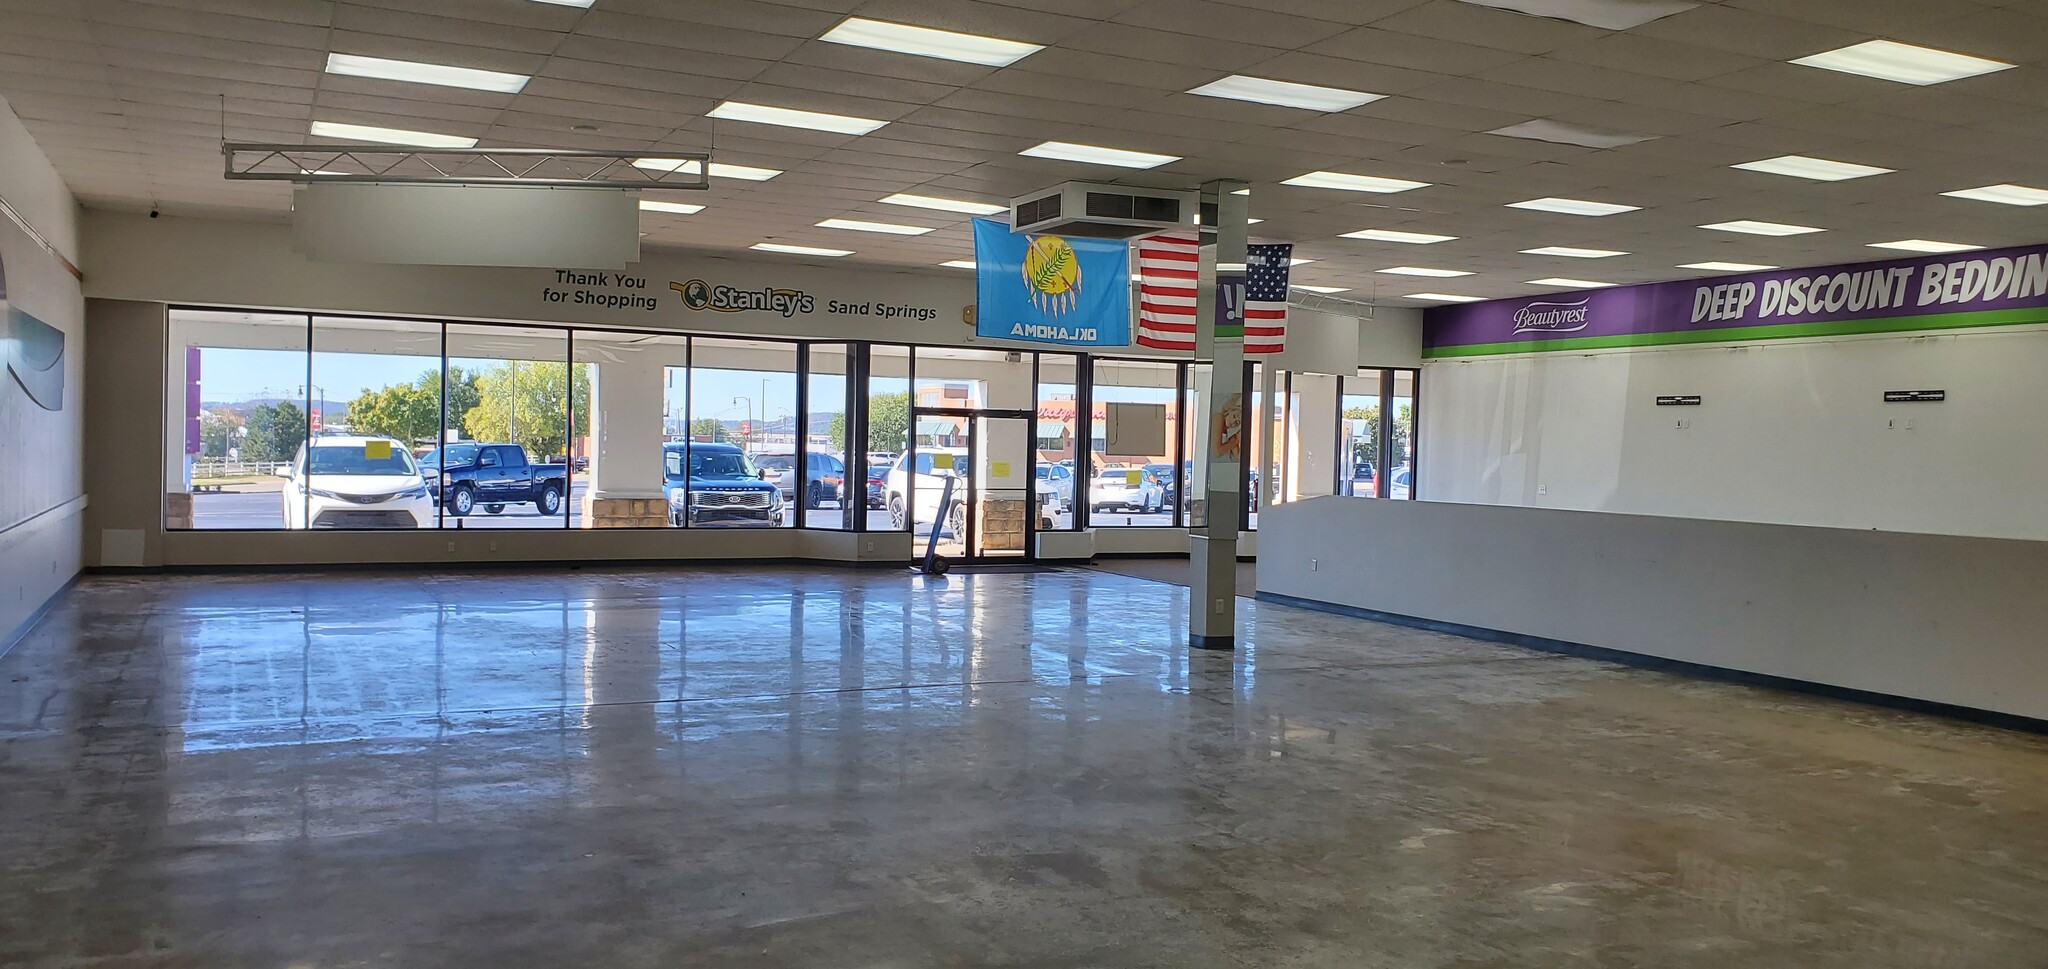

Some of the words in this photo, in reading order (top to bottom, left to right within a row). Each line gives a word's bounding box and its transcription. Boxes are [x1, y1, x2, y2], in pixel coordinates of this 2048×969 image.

[555, 269, 608, 287] Thank
[614, 273, 646, 289] You
[1691, 282, 1756, 323] DEEP
[1758, 266, 1914, 318] DISCOUNT
[1917, 250, 2048, 306] BEDDIN
[542, 287, 569, 303] for
[573, 290, 657, 311] Shopping
[713, 285, 814, 318] Stanley's
[828, 300, 871, 316] Sand
[875, 302, 937, 321] Springs
[1513, 305, 1589, 330] Beautyrest
